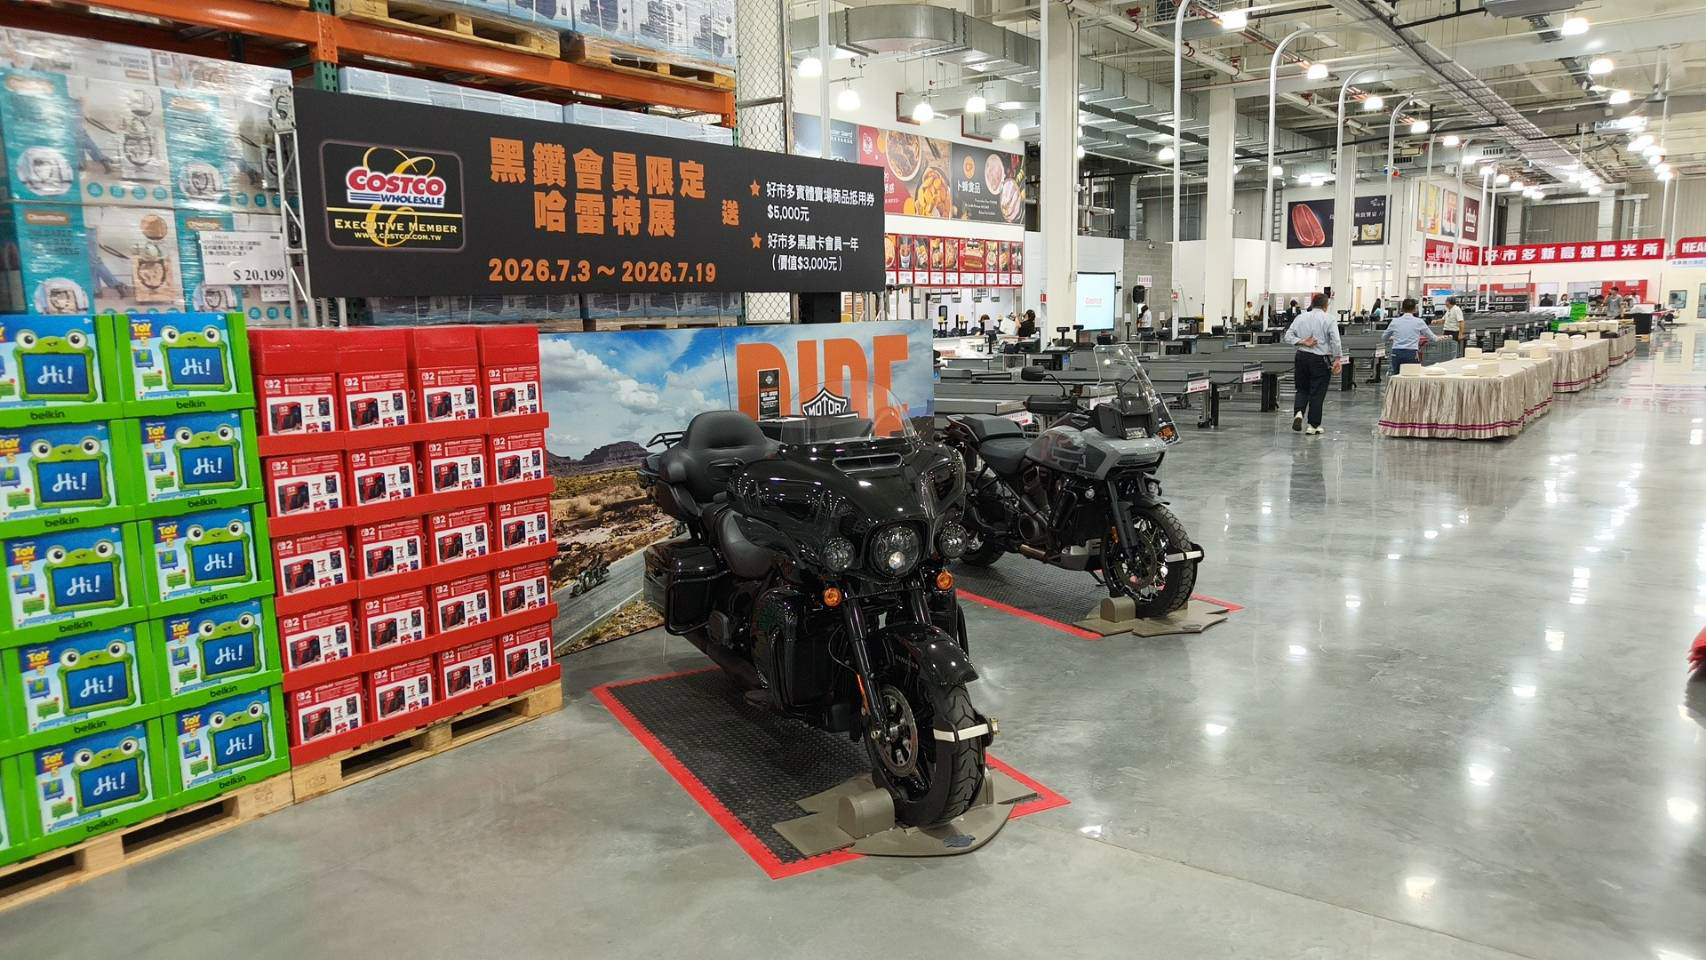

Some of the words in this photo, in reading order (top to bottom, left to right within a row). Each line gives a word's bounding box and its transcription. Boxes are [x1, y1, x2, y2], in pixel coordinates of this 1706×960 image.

[490, 137, 706, 199] 黑鑽會員限定
[347, 168, 444, 196] COSTCO
[380, 193, 443, 206] WHOLESALE
[766, 181, 875, 207] 好市多實體賣場商品抵用券
[534, 190, 675, 238] 哈雷特展
[720, 199, 740, 226] 送
[767, 204, 810, 222] $5,000元
[408, 221, 457, 233] MEMBER
[767, 233, 859, 252] 好市多黑鑽卡會員一年
[232, 269, 241, 281] $
[244, 269, 285, 281] 20,199
[488, 257, 591, 282] 2026.7.3
[621, 260, 717, 283] 2026.7.19
[131, 323, 151, 333] TOY
[181, 358, 211, 375] Hi!
[37, 365, 73, 384] Hi!
[176, 400, 206, 409] belkin
[807, 399, 842, 416] MOTOR
[30, 410, 65, 420] belkin
[145, 425, 166, 436] TOY
[193, 457, 222, 475] Hi!
[52, 472, 87, 492] Hi!
[187, 498, 217, 507] belkin
[44, 517, 79, 527] belkin
[158, 524, 178, 535] TOY
[12, 545, 36, 556] TOY
[204, 552, 233, 571] Hi!
[66, 574, 100, 596] Hi!
[199, 593, 228, 604] belkin
[59, 620, 93, 632] belkin
[170, 621, 190, 633] TOY
[215, 644, 243, 665] Hi!
[80, 675, 113, 698] Hi!
[209, 685, 238, 697] belkin
[74, 720, 106, 733] belkin
[182, 713, 201, 726] TOY
[226, 733, 253, 755] Hi!
[93, 772, 126, 796] Hi!
[219, 776, 246, 790] belkin
[86, 818, 118, 832] belkin
